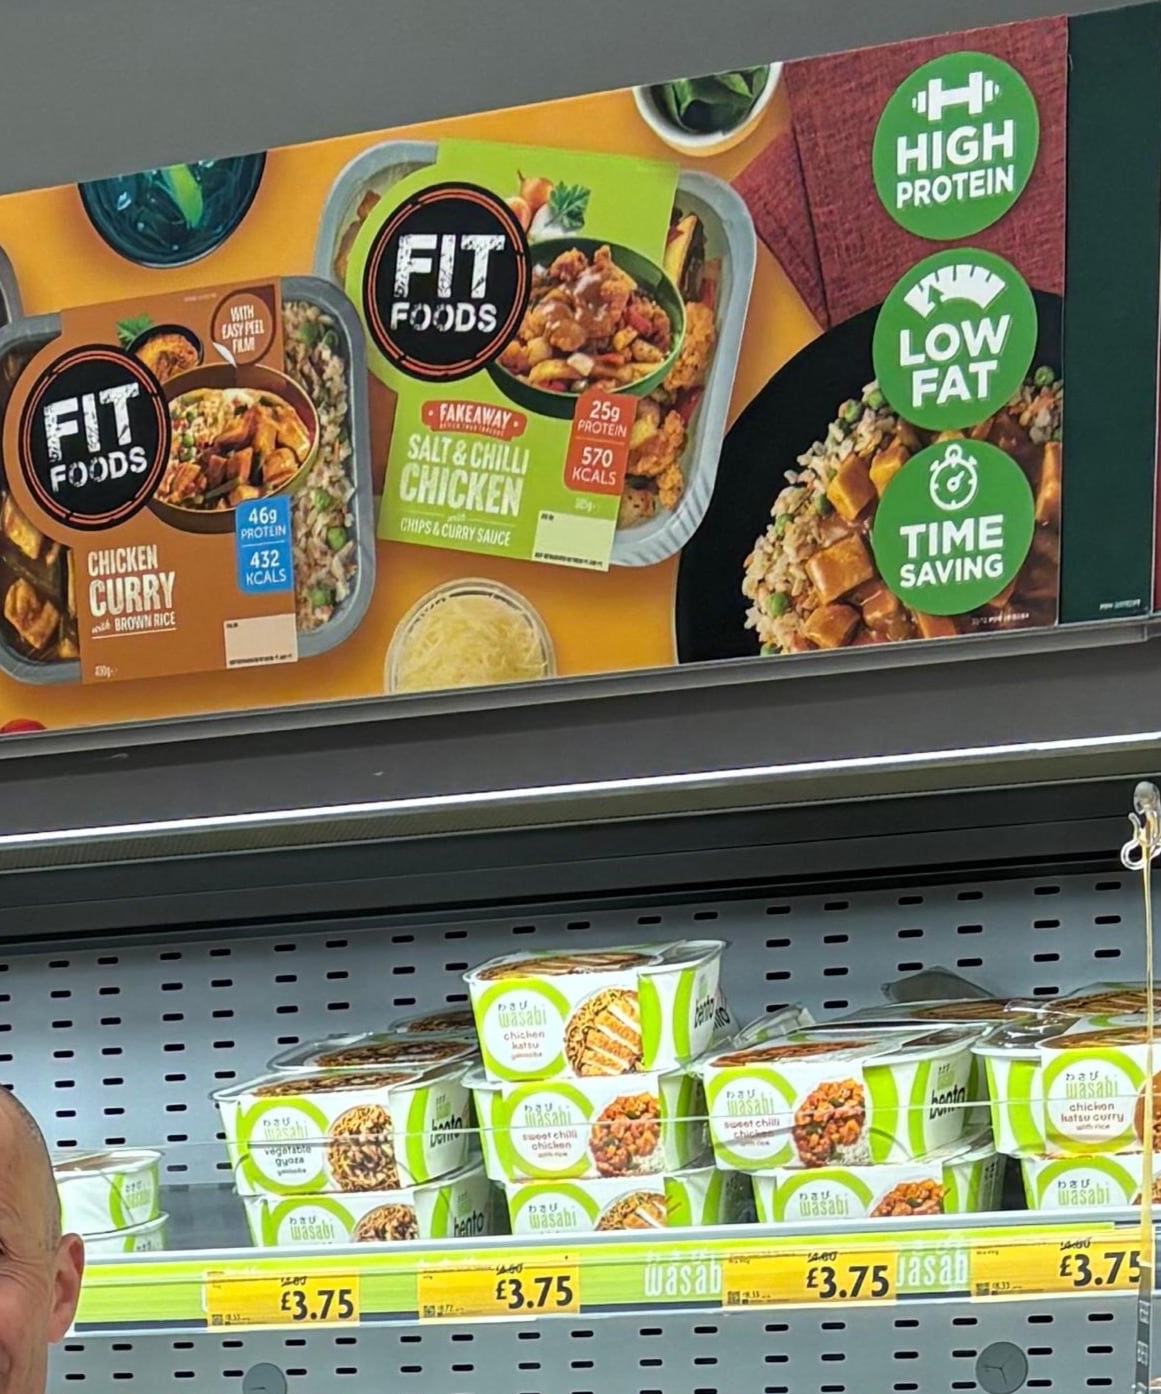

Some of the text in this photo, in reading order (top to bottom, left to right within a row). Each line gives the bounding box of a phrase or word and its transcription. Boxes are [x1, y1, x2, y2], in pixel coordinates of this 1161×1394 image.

[895, 119, 1015, 175] HIGH
[895, 165, 1015, 209] PROTEIN
[393, 234, 506, 298] FIT
[230, 305, 254, 322] WITH
[390, 302, 497, 332] FOODS
[241, 318, 264, 336] PEEL
[900, 315, 1011, 366] LOW
[911, 361, 998, 408] FAT
[43, 382, 140, 462] FIT
[440, 403, 513, 429] FAKEAWAY
[590, 400, 620, 422] 25g
[577, 420, 628, 438] PROTEIN
[407, 433, 450, 463] SALT
[469, 441, 530, 475] CHILLI
[581, 447, 613, 468] 570
[50, 446, 148, 493] FOODS
[572, 466, 616, 486] KCALS
[399, 462, 524, 518] CHICKEN
[248, 507, 278, 526] 46g
[241, 525, 286, 540] PROTEIN
[400, 517, 431, 535] CHIPS
[442, 523, 476, 541] CURRY
[477, 528, 511, 547] SAUCE
[900, 515, 1005, 559] TIME
[87, 544, 158, 576] CHICKEN
[250, 549, 280, 569] 432
[900, 553, 1004, 589] SAVING
[246, 569, 287, 586] KCALS
[89, 571, 176, 617] CURRY
[114, 610, 176, 632] BROWN RICE
[498, 1006, 547, 1029] wasabi
[503, 1030, 545, 1041] chicken
[1066, 1075, 1118, 1099] wasabi
[525, 1106, 572, 1127] wasabi
[1069, 1102, 1115, 1111] chicken
[531, 1141, 572, 1151] chicken
[799, 1194, 849, 1217] wasabi
[1058, 1182, 1110, 1206] wasabi
[289, 1219, 335, 1241] wasabi
[529, 1206, 576, 1230] wasabi
[806, 1264, 889, 1299] £3.75
[1059, 1251, 1140, 1288] £3.75
[495, 1274, 573, 1310] £3.75
[281, 1289, 354, 1322] £3.75
